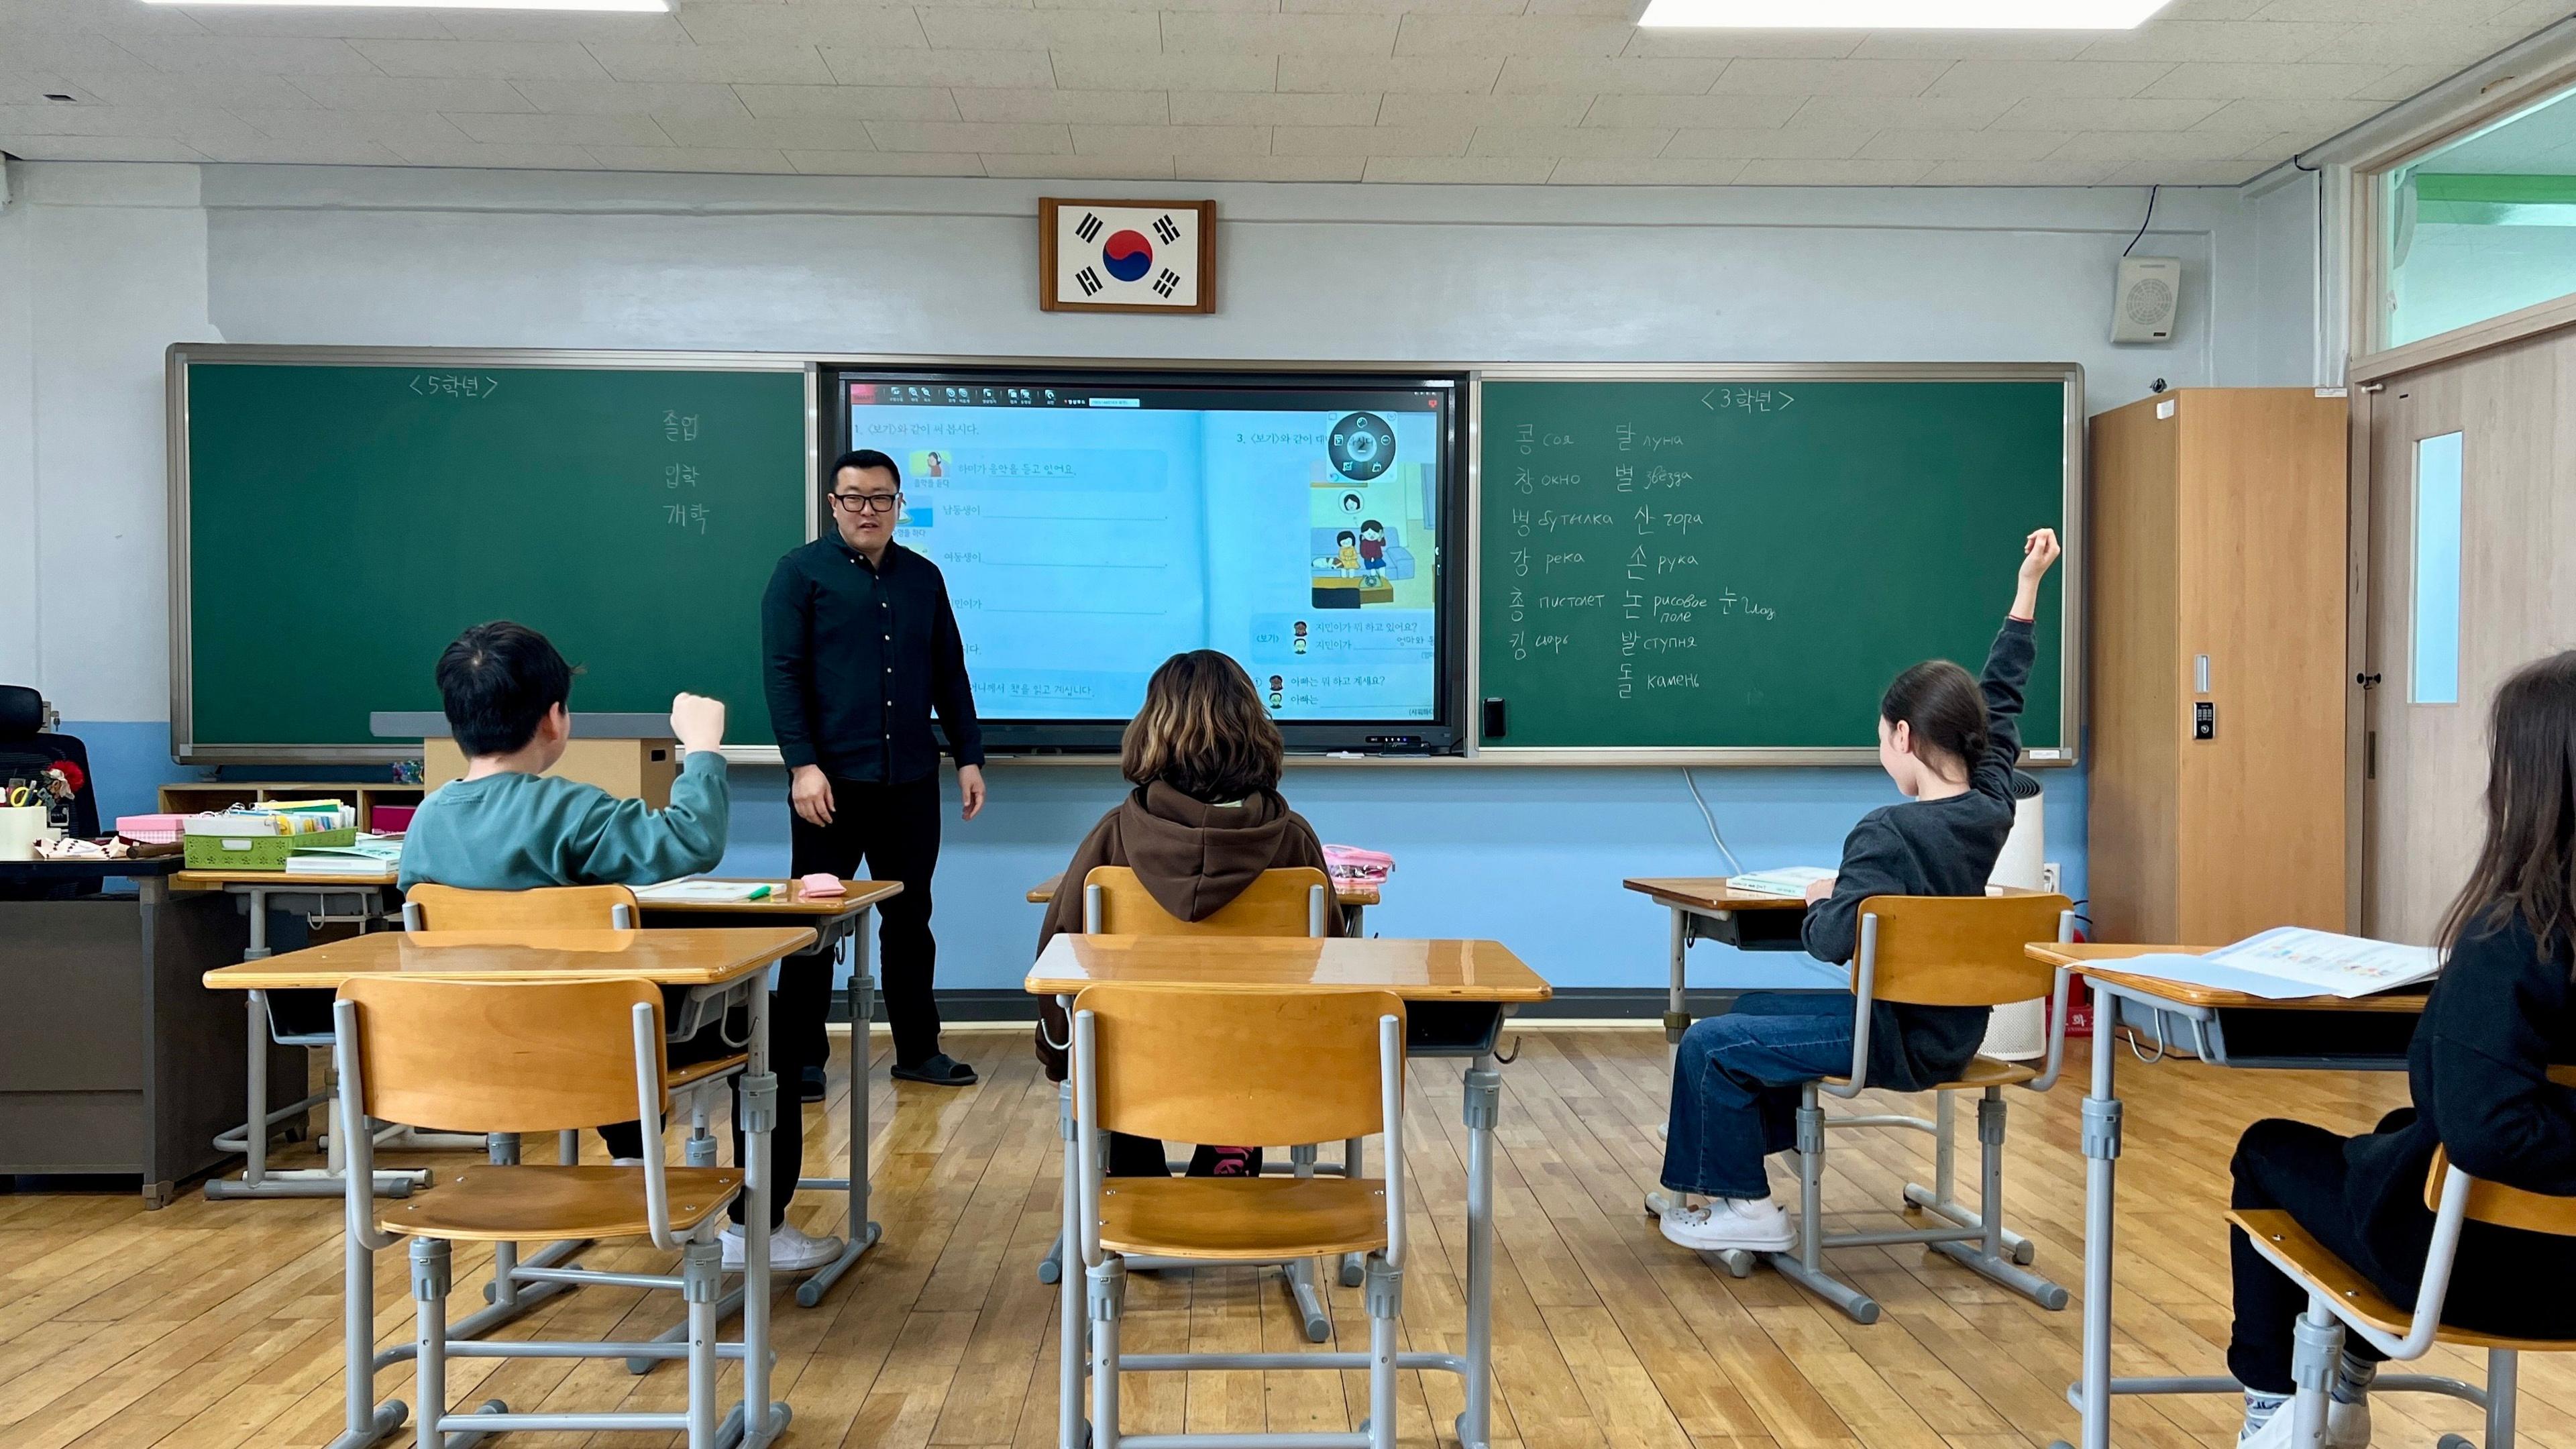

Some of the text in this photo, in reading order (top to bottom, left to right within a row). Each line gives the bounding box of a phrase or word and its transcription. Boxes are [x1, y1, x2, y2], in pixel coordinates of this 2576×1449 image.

[663, 410, 698, 442] 졸업
[910, 423, 930, 435] 같이
[934, 424, 943, 435] 써
[946, 423, 979, 435] 봅시다.
[1236, 433, 1247, 445] 3.
[1293, 433, 1312, 445] 같이
[1515, 423, 1574, 455] 콩 соя
[1615, 421, 1684, 452] 달 луна
[665, 463, 700, 489] 입학
[958, 463, 1077, 476] 하미가 음악을 듣고 있어요.
[1514, 466, 1580, 495] 창 окно
[1615, 463, 1633, 492] 별
[662, 503, 710, 535] 개학
[943, 504, 981, 517] 남동생이
[1512, 507, 1614, 537] 병 бутылка
[1634, 504, 1704, 536] 산 гора
[944, 552, 981, 564] 여동생이
[1509, 547, 1585, 577] 강 река
[1625, 544, 1699, 581] 손 рука
[1509, 586, 1605, 622] 총 пистолет
[1622, 590, 1707, 619] 논 рисовое
[1719, 586, 1737, 615] 눈
[1316, 622, 1351, 633] 지민이가
[1365, 622, 1384, 633] 하고
[1385, 622, 1417, 633] 있어요?
[1660, 611, 1692, 624] поле
[1316, 639, 1352, 651] 지민이가
[1397, 636, 1424, 647] 엄마와
[1508, 630, 1527, 661] 킹
[1621, 629, 1698, 657] 발 ступня
[1010, 684, 1030, 695] 책을
[1033, 684, 1051, 696] 읽고
[1054, 684, 1095, 697] 계십니다.
[1291, 676, 1319, 687] 아빠는
[1332, 676, 1351, 687] 하고
[1617, 663, 1700, 699] 돌 камень
[1290, 694, 1319, 706] 아빠는
